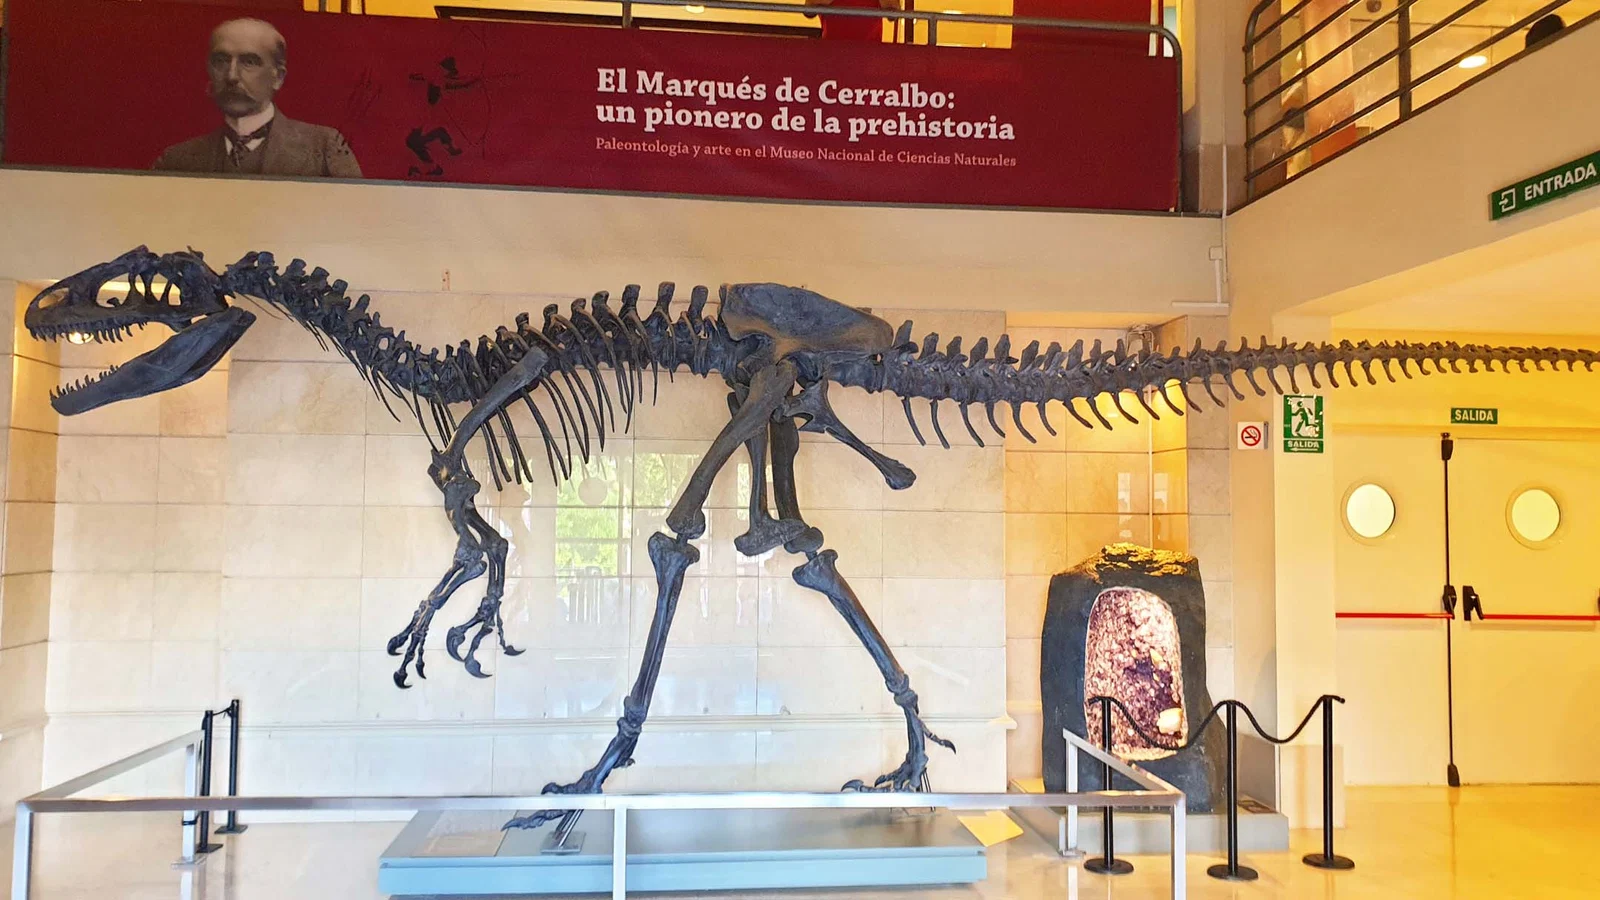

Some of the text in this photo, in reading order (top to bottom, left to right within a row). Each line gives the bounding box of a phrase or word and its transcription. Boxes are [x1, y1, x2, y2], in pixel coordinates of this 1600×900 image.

[596, 67, 956, 110] El Marqués de Cerralbo:
[595, 100, 1016, 142] un pionero de la prehistoria
[596, 137, 1016, 167] Paleontología y arte en el Museo Nacional de Ciencias Naturales
[1524, 162, 1598, 201] ENTRADA
[1454, 409, 1494, 422] SALIDA
[1287, 440, 1320, 448] SALIDA
